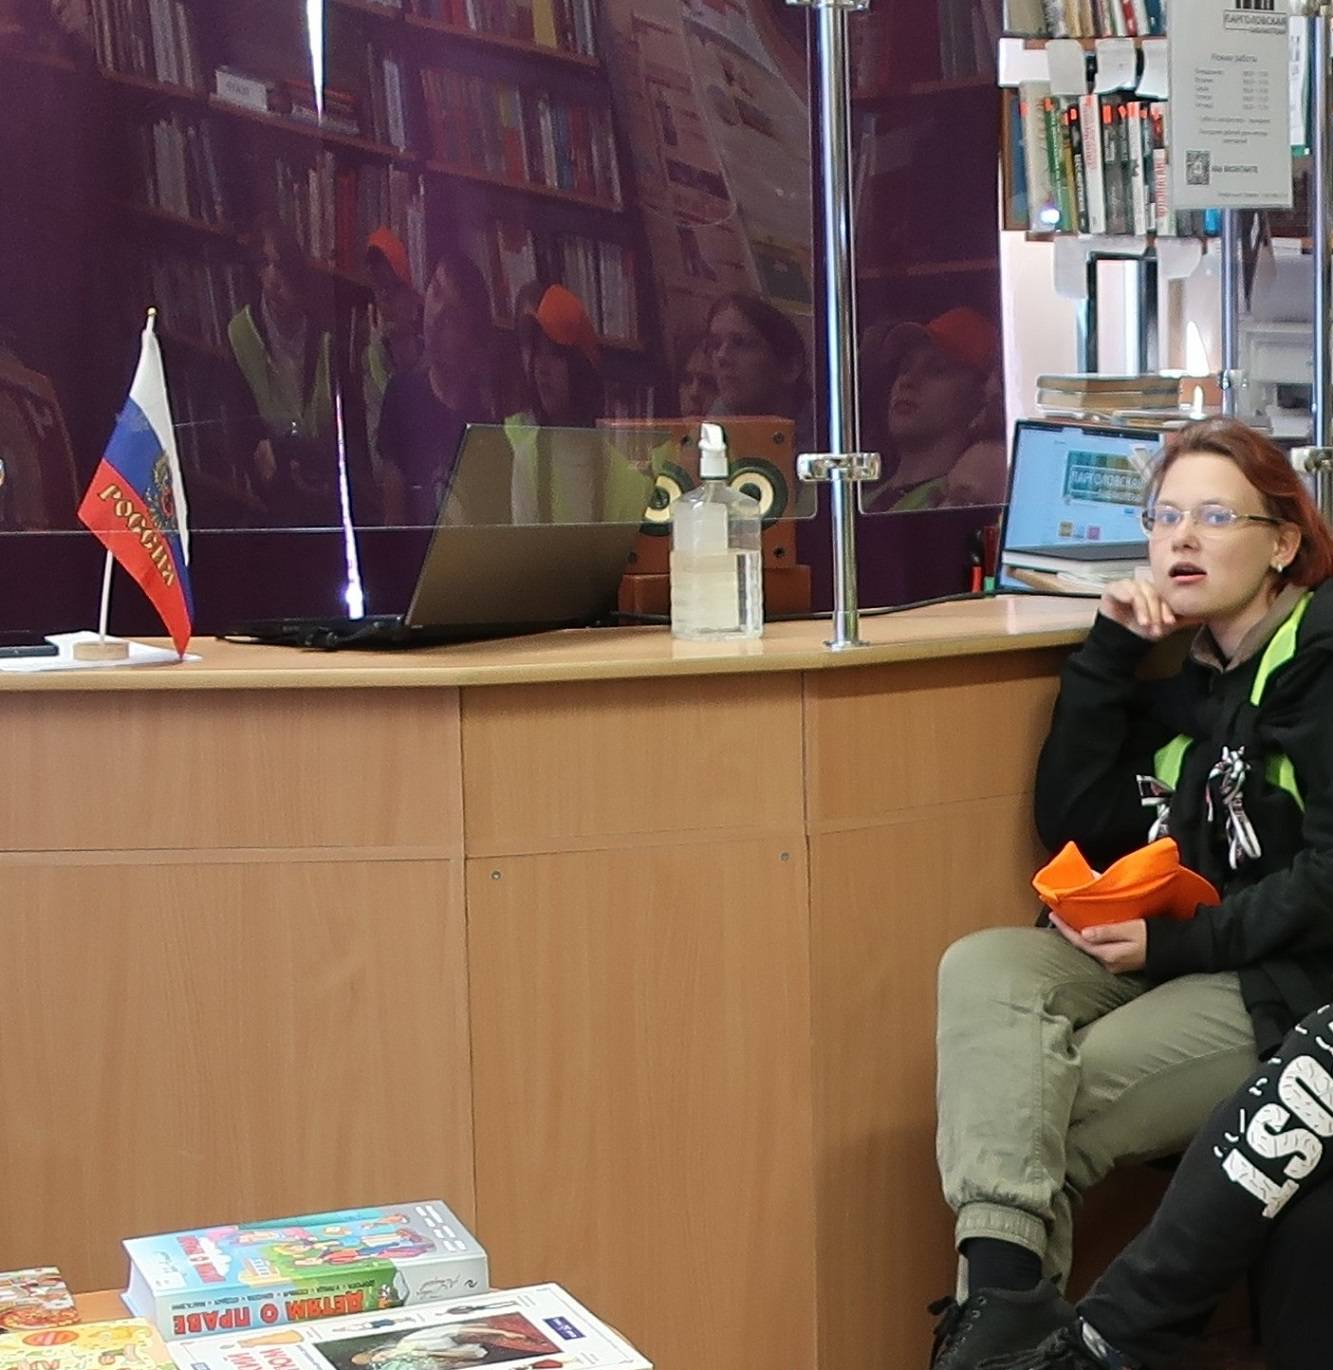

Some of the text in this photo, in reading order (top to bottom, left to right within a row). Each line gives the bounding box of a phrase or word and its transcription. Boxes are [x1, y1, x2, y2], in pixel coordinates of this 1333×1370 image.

[98, 483, 175, 587] РОССИЯ
[173, 1290, 364, 1336] ДЕТЯМ О ПРАВЕ
